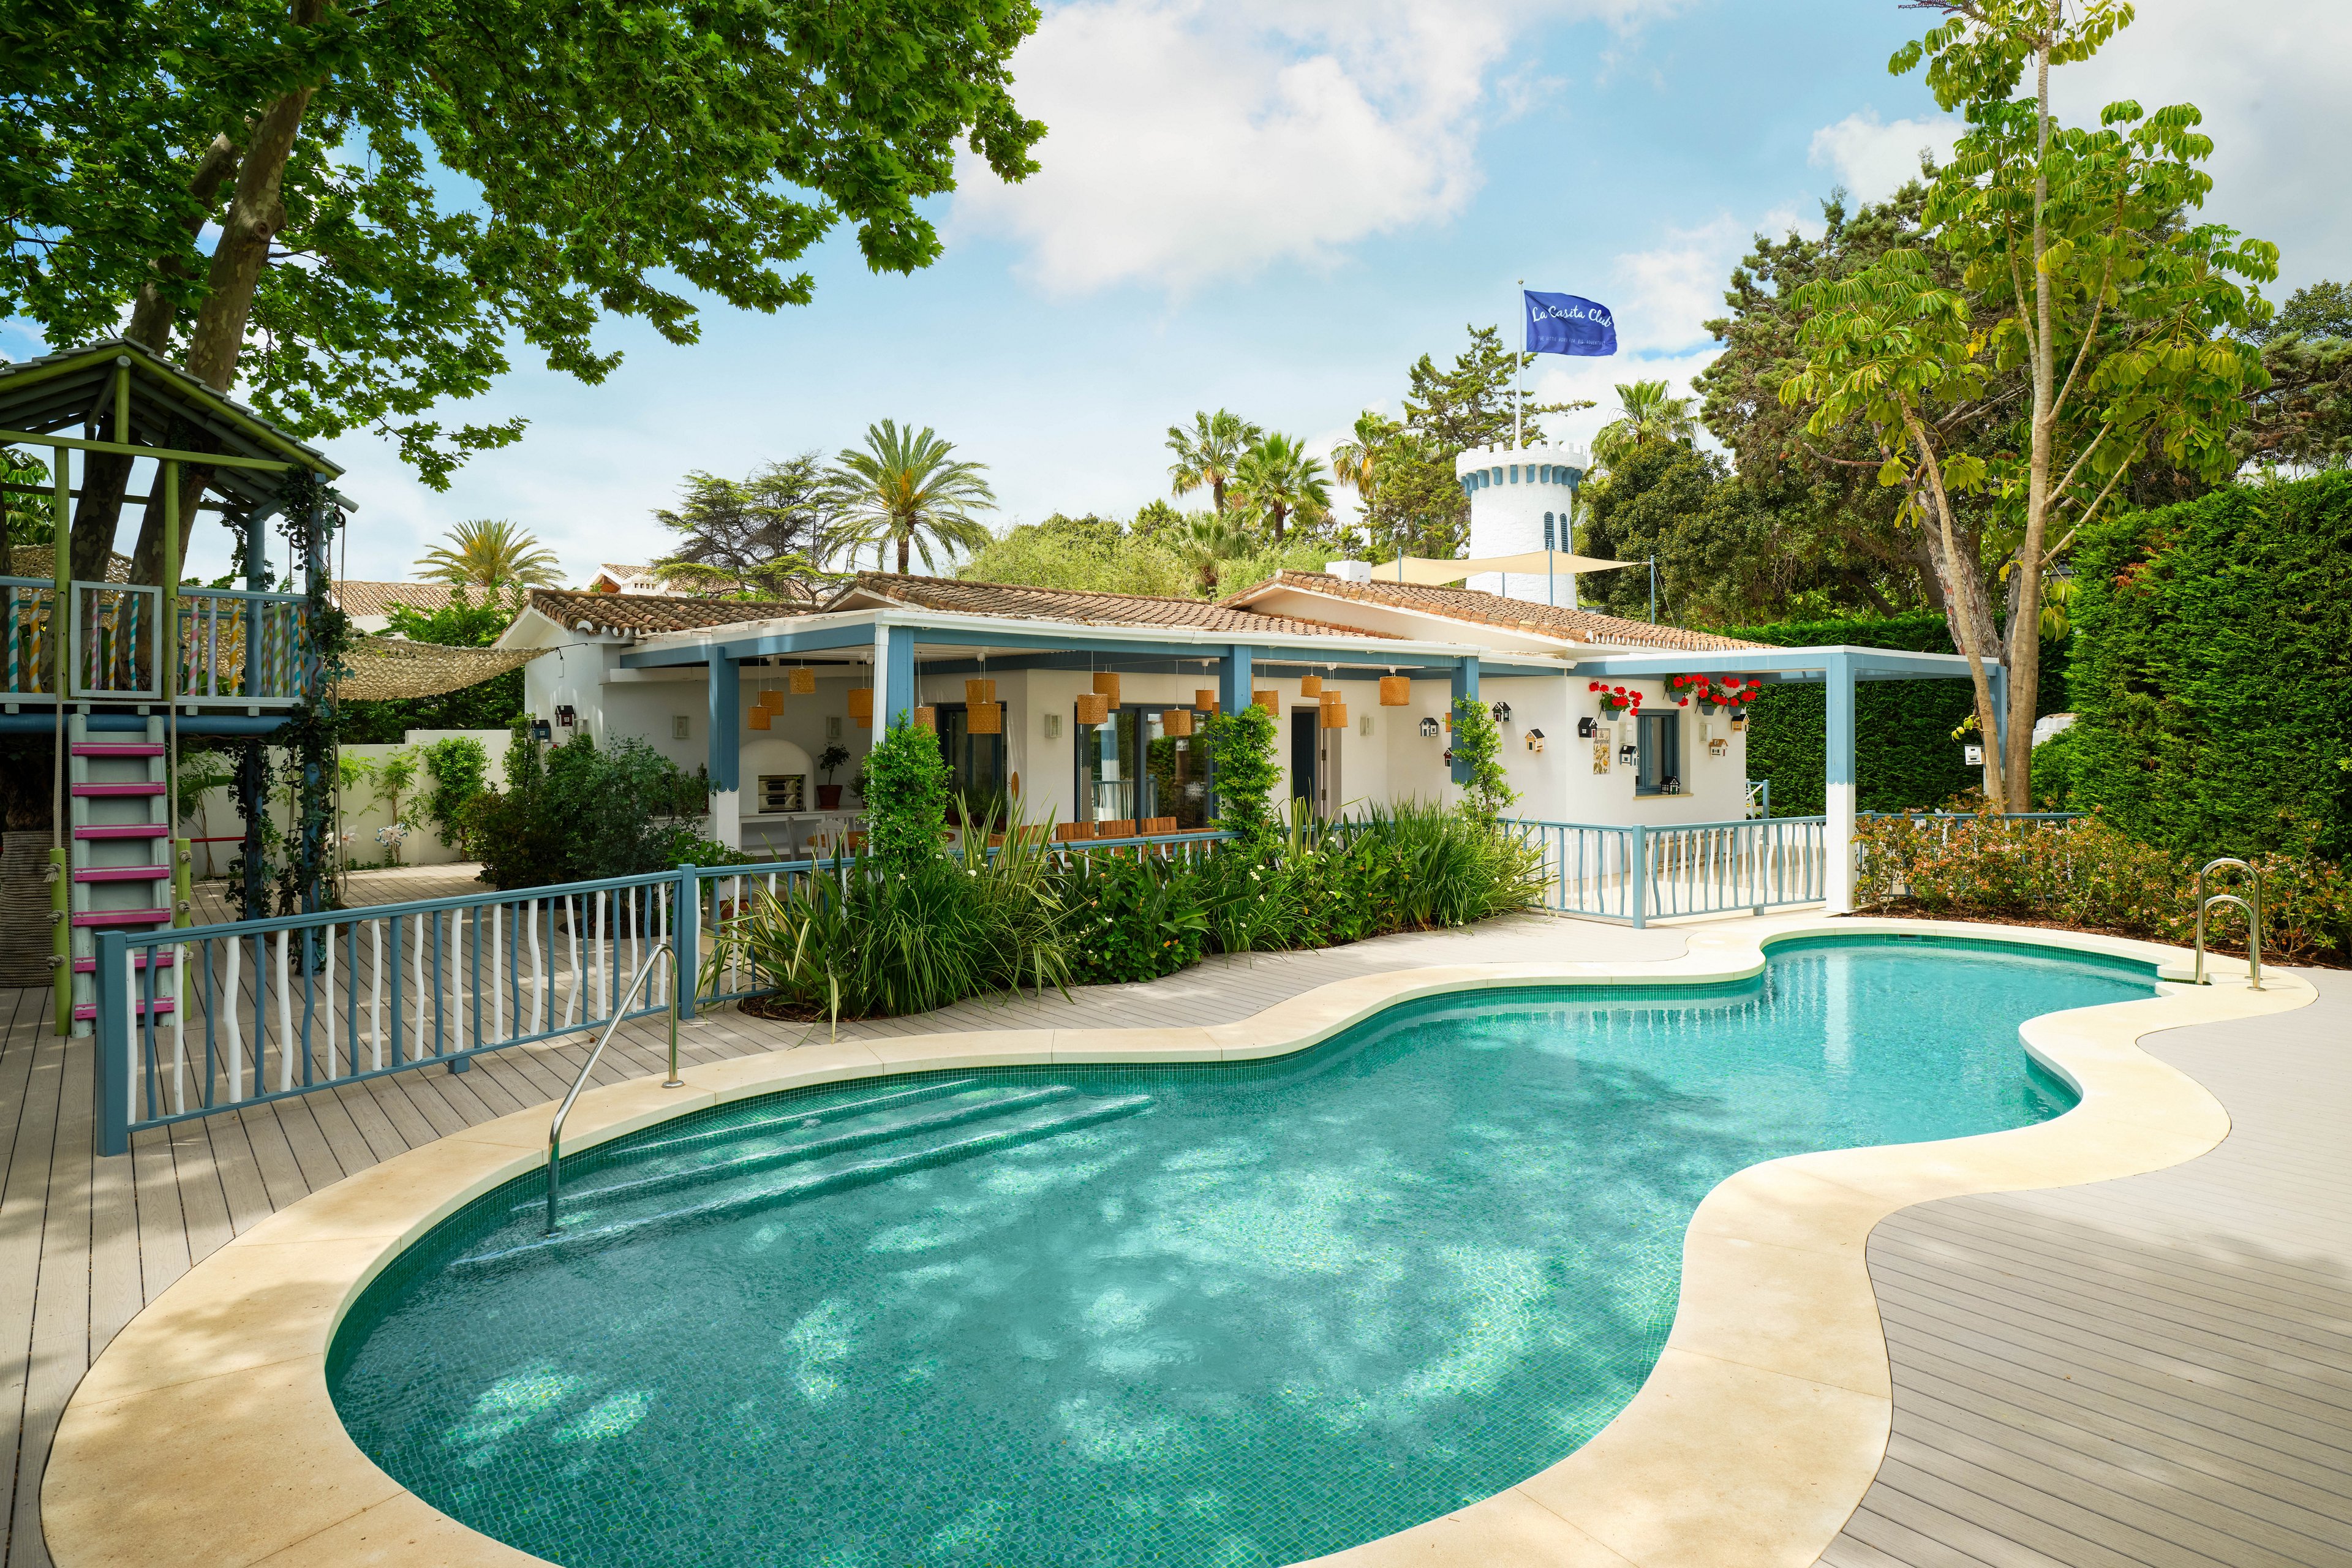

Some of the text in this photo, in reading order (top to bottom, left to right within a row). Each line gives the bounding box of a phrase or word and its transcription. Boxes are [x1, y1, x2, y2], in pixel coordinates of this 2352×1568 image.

[1532, 305, 1612, 327] La Casita Club
